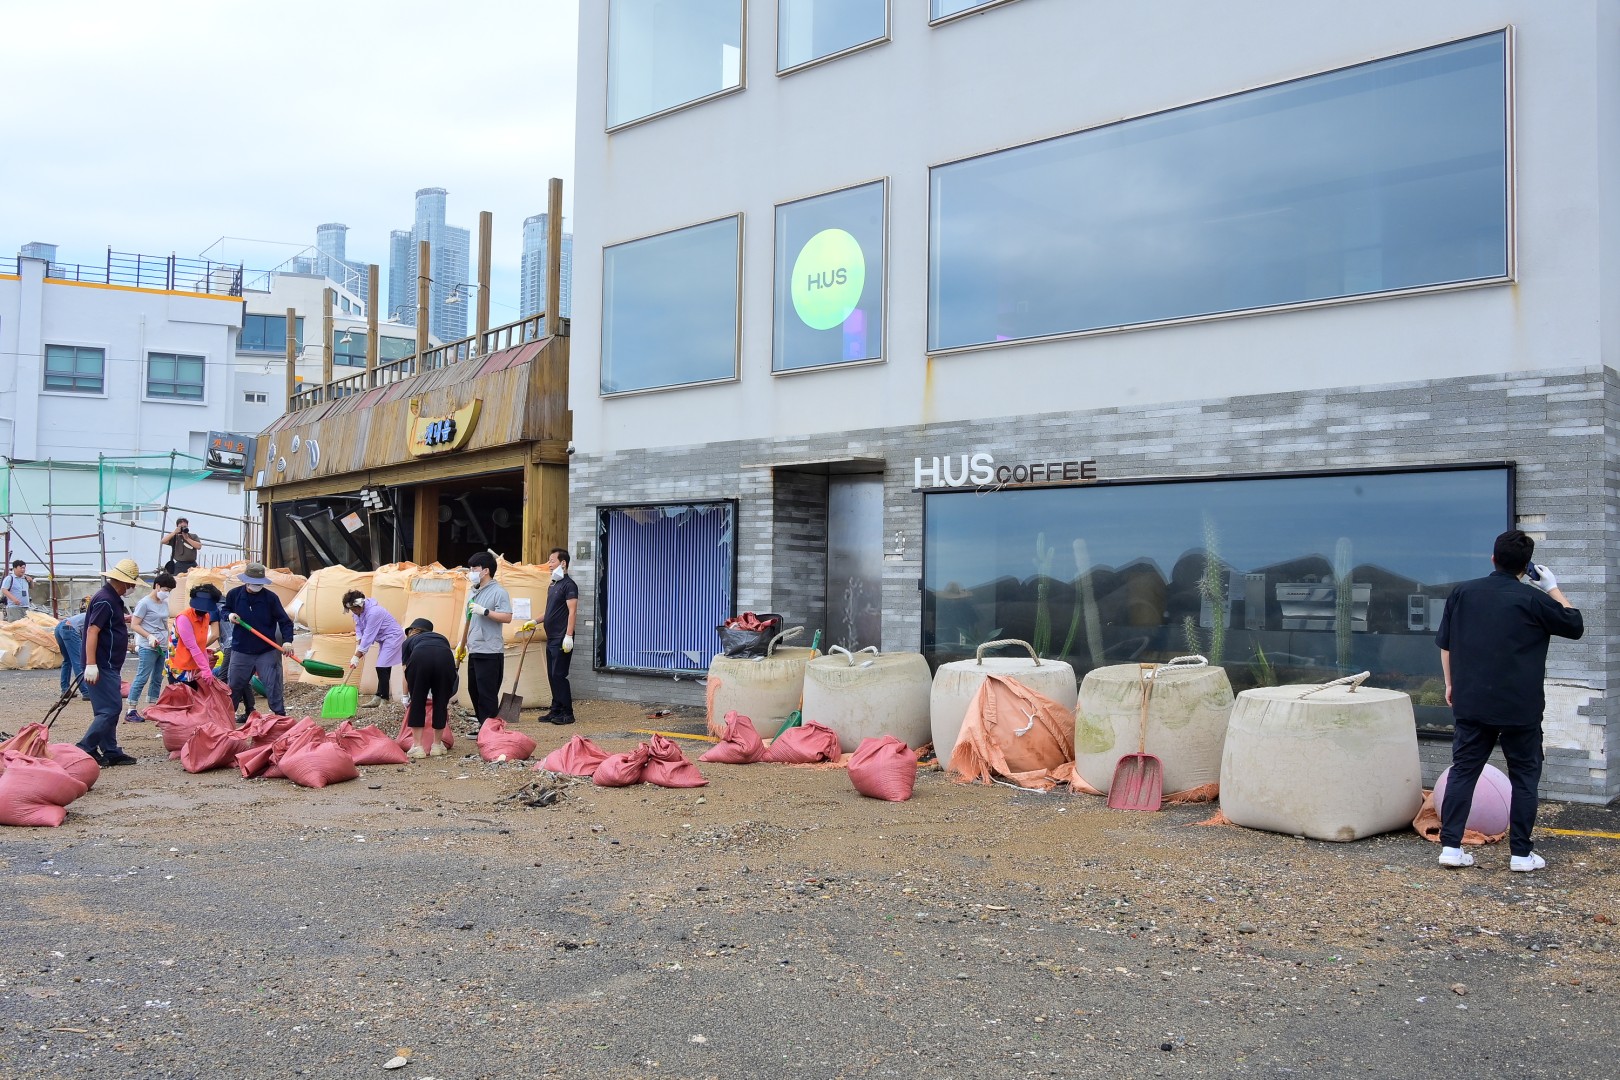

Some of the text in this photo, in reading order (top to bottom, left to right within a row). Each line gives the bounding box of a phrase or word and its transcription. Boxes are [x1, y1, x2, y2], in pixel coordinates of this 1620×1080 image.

[807, 267, 847, 291] H.US
[914, 453, 1097, 488] H.US COFFEE
